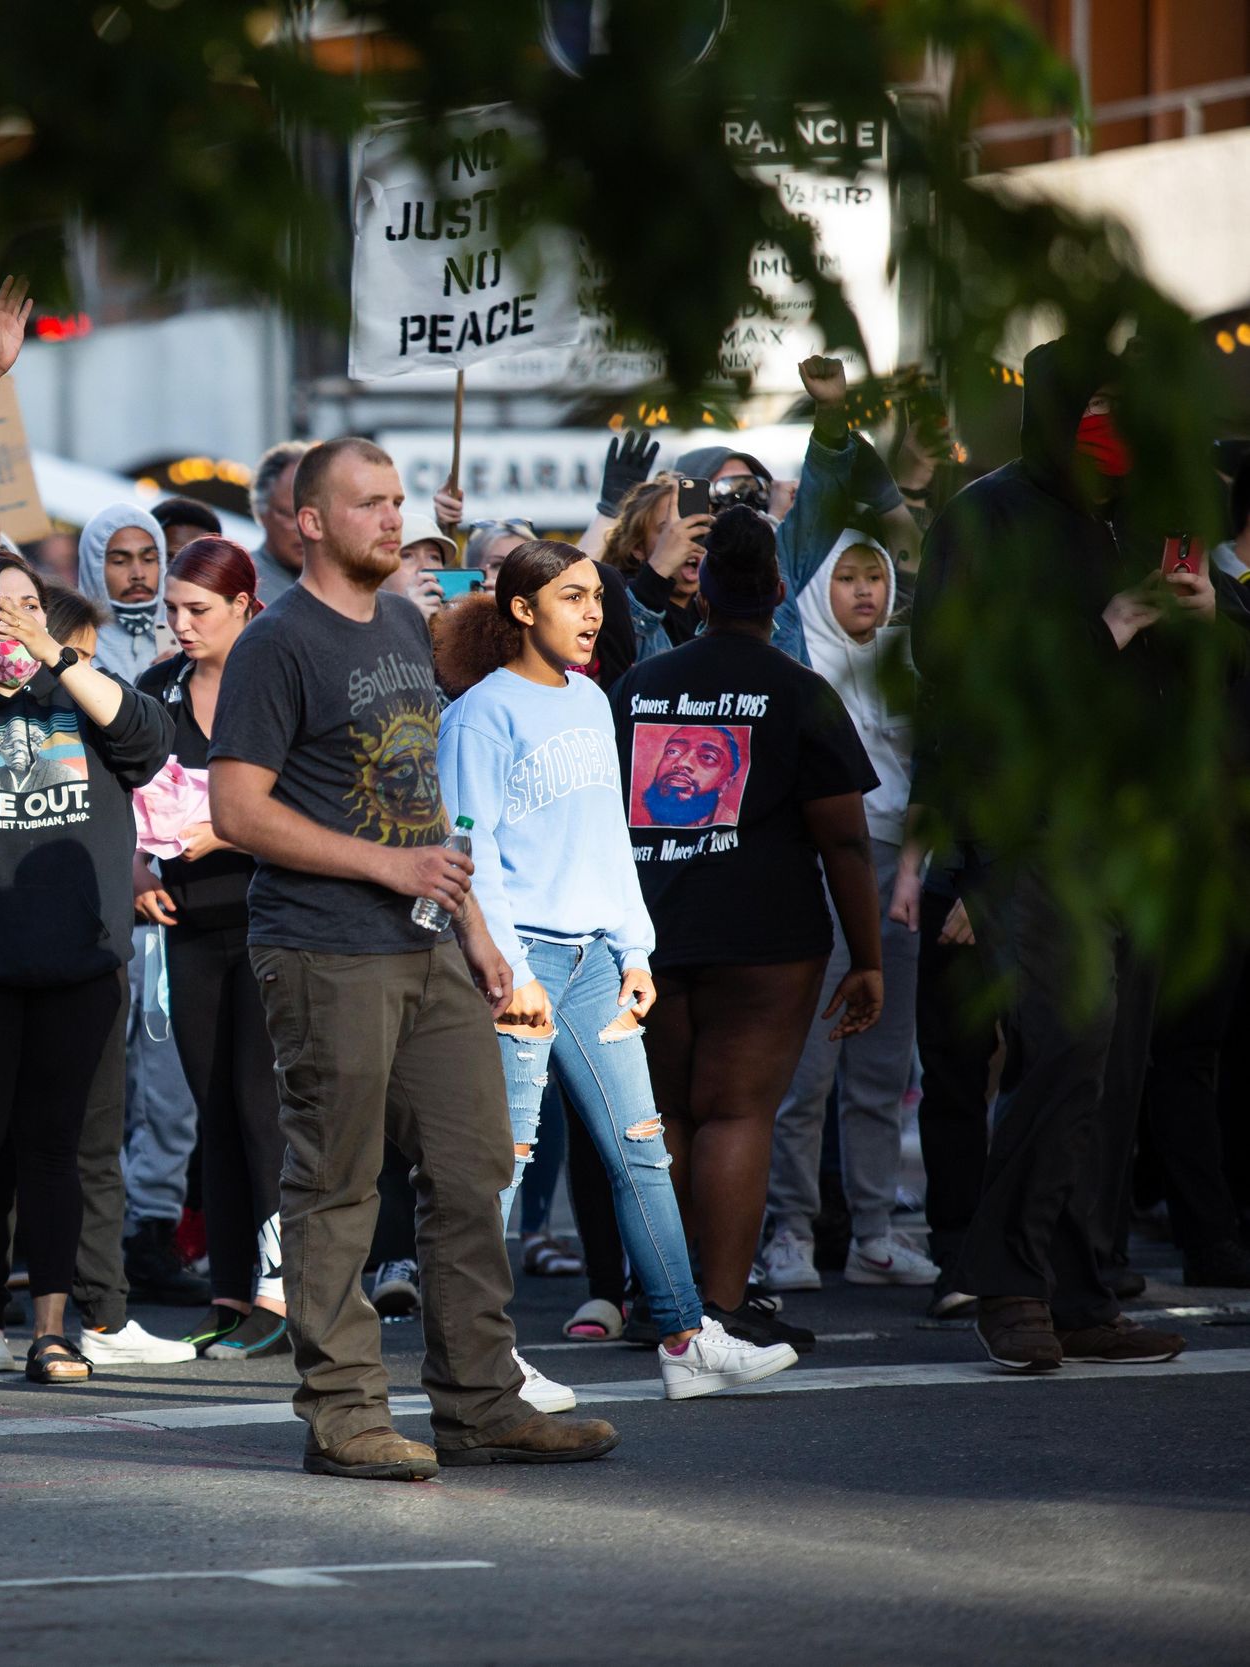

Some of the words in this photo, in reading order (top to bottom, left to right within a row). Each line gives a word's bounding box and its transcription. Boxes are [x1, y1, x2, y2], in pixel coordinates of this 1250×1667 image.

[443, 249, 502, 297] NO
[400, 293, 537, 357] PEACE
[735, 693, 769, 718] 1985
[24, 783, 90, 817] OUT.
[17, 816, 65, 830] TUBMAN,
[710, 830, 739, 852] 2019
